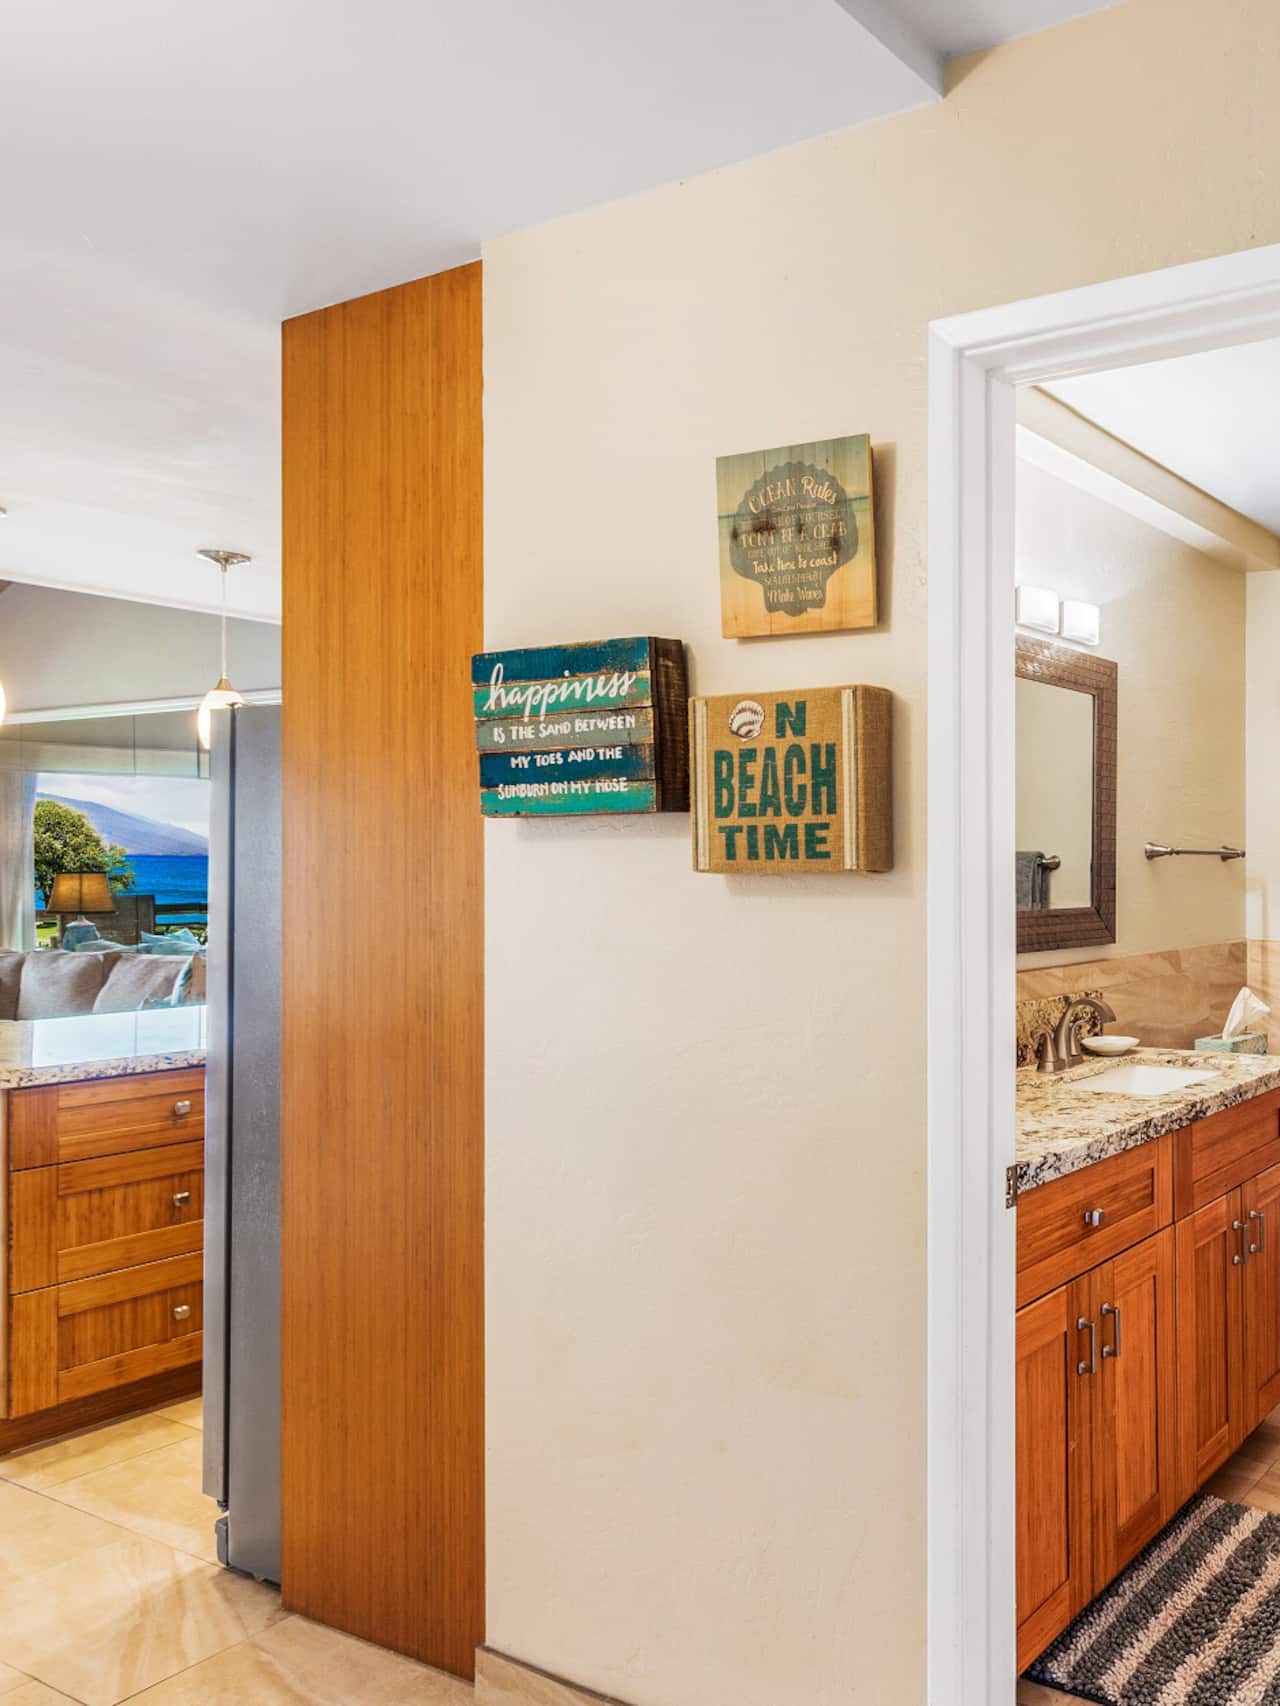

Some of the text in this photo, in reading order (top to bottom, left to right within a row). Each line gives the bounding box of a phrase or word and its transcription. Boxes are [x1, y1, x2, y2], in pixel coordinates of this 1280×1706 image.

[801, 475, 838, 505] Rules
[809, 551, 838, 568] coast
[482, 663, 636, 722] happiness
[493, 715, 636, 744] IS THE SAND BETWEEN
[510, 747, 623, 769] MY TOES AND THE
[497, 777, 629, 800] SUNBURN ON MY NOSE
[713, 742, 838, 819] BEACH
[718, 822, 831, 861] TIME
